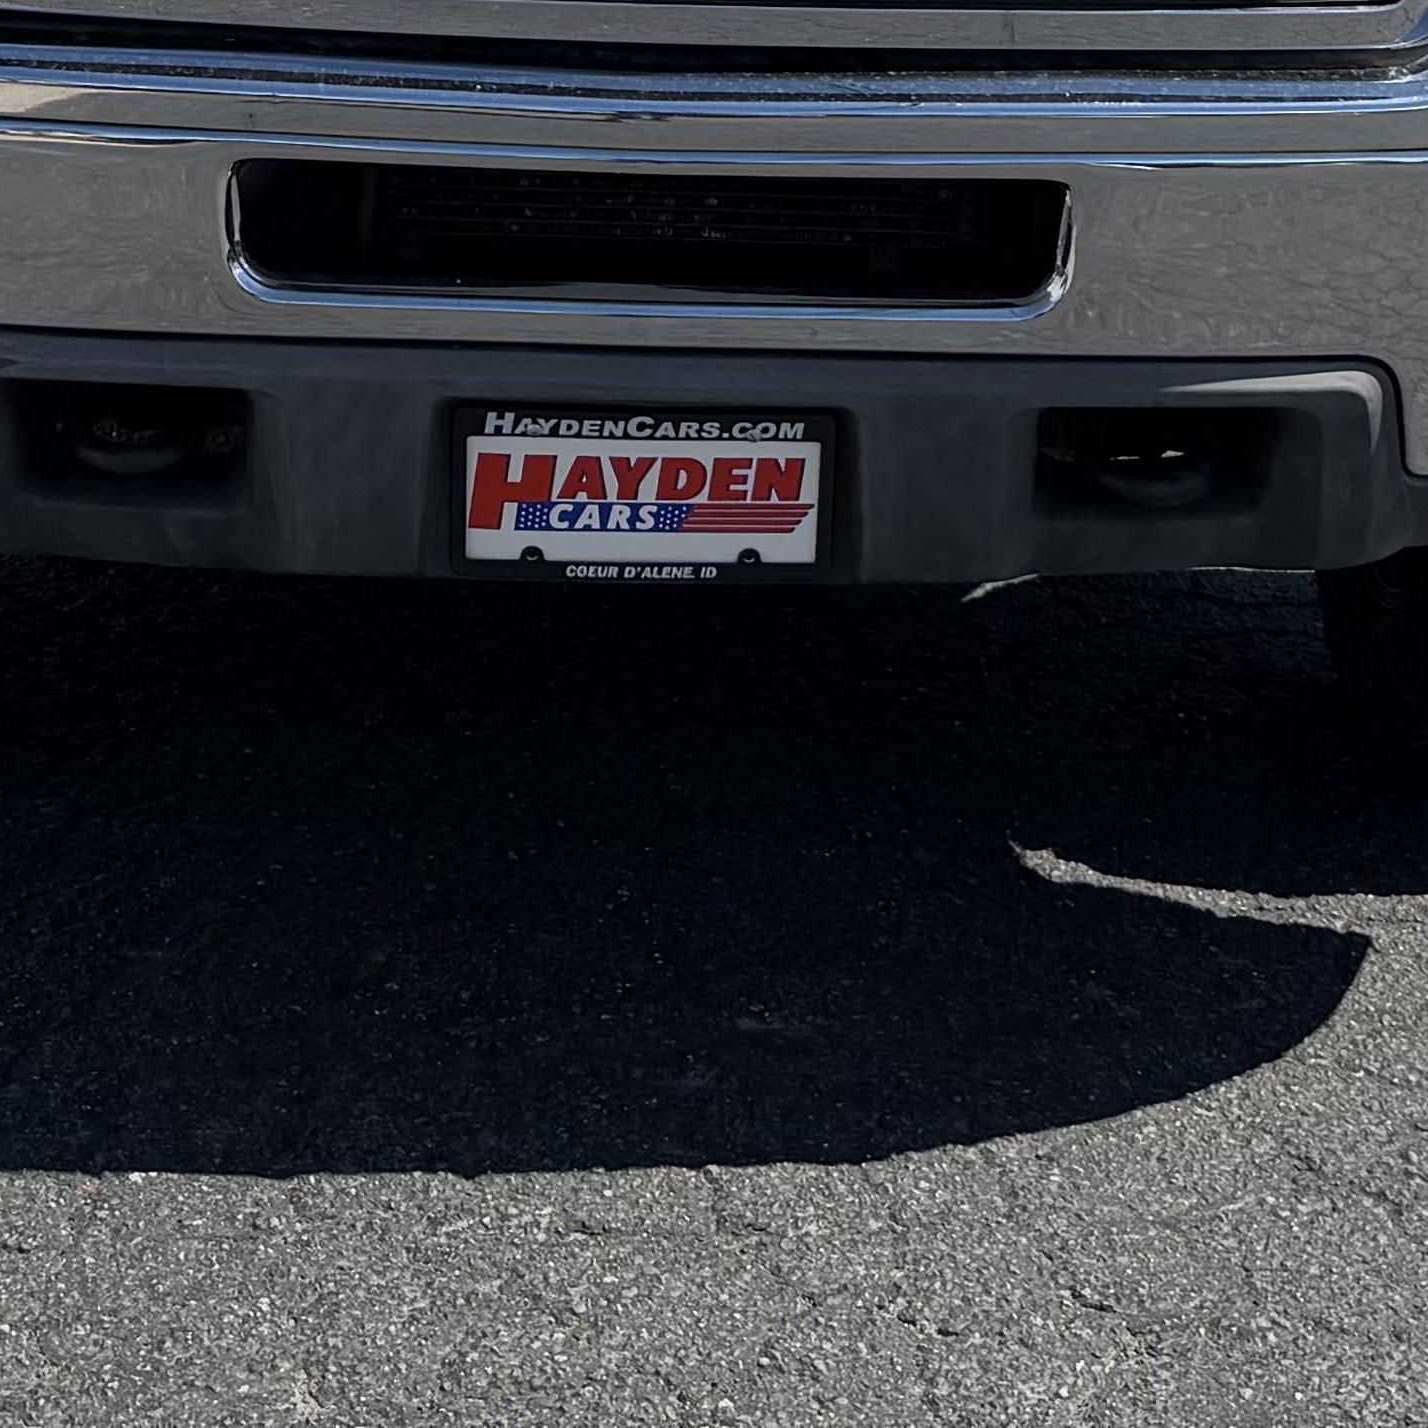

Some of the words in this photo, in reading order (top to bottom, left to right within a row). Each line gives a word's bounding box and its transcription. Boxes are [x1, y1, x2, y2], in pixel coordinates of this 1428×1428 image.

[468, 453, 806, 530] HAYDEN
[548, 504, 659, 531] CARS
[565, 565, 619, 579] COEUR
[701, 567, 717, 579] ID
